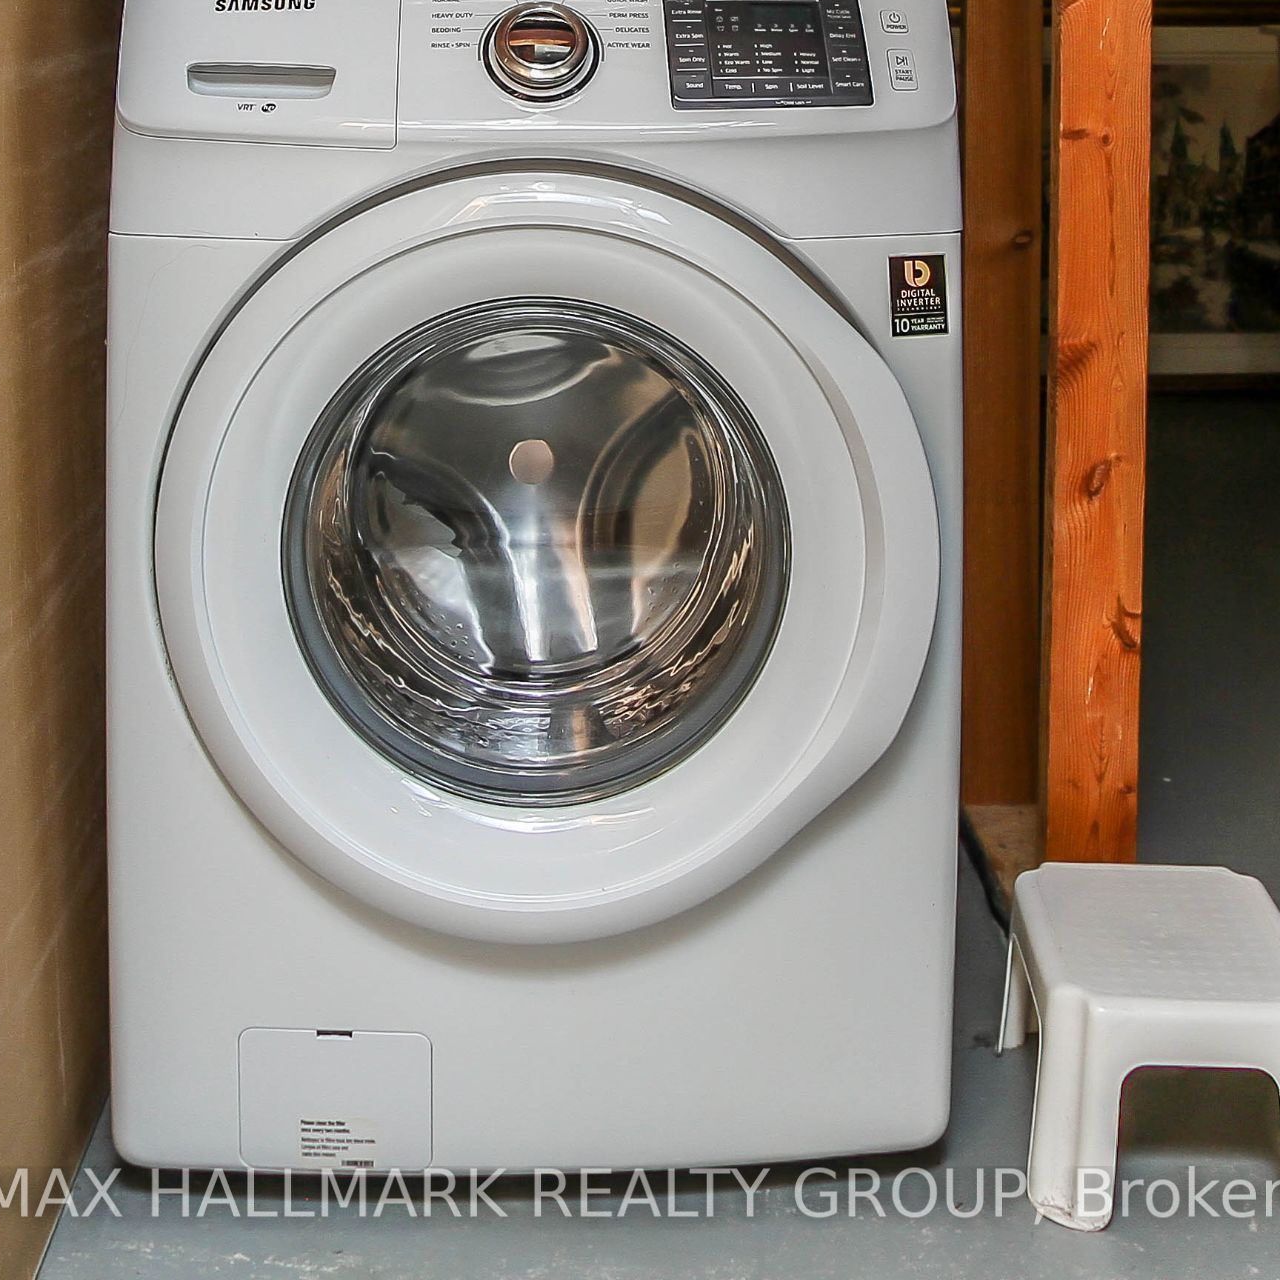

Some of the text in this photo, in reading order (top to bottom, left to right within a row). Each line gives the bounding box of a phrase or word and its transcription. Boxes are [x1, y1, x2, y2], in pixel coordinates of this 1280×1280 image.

[900, 288, 936, 299] DIGITAL
[896, 297, 941, 307] INVERTER
[894, 318, 910, 333] 10
[910, 323, 945, 331] WARRANTY
